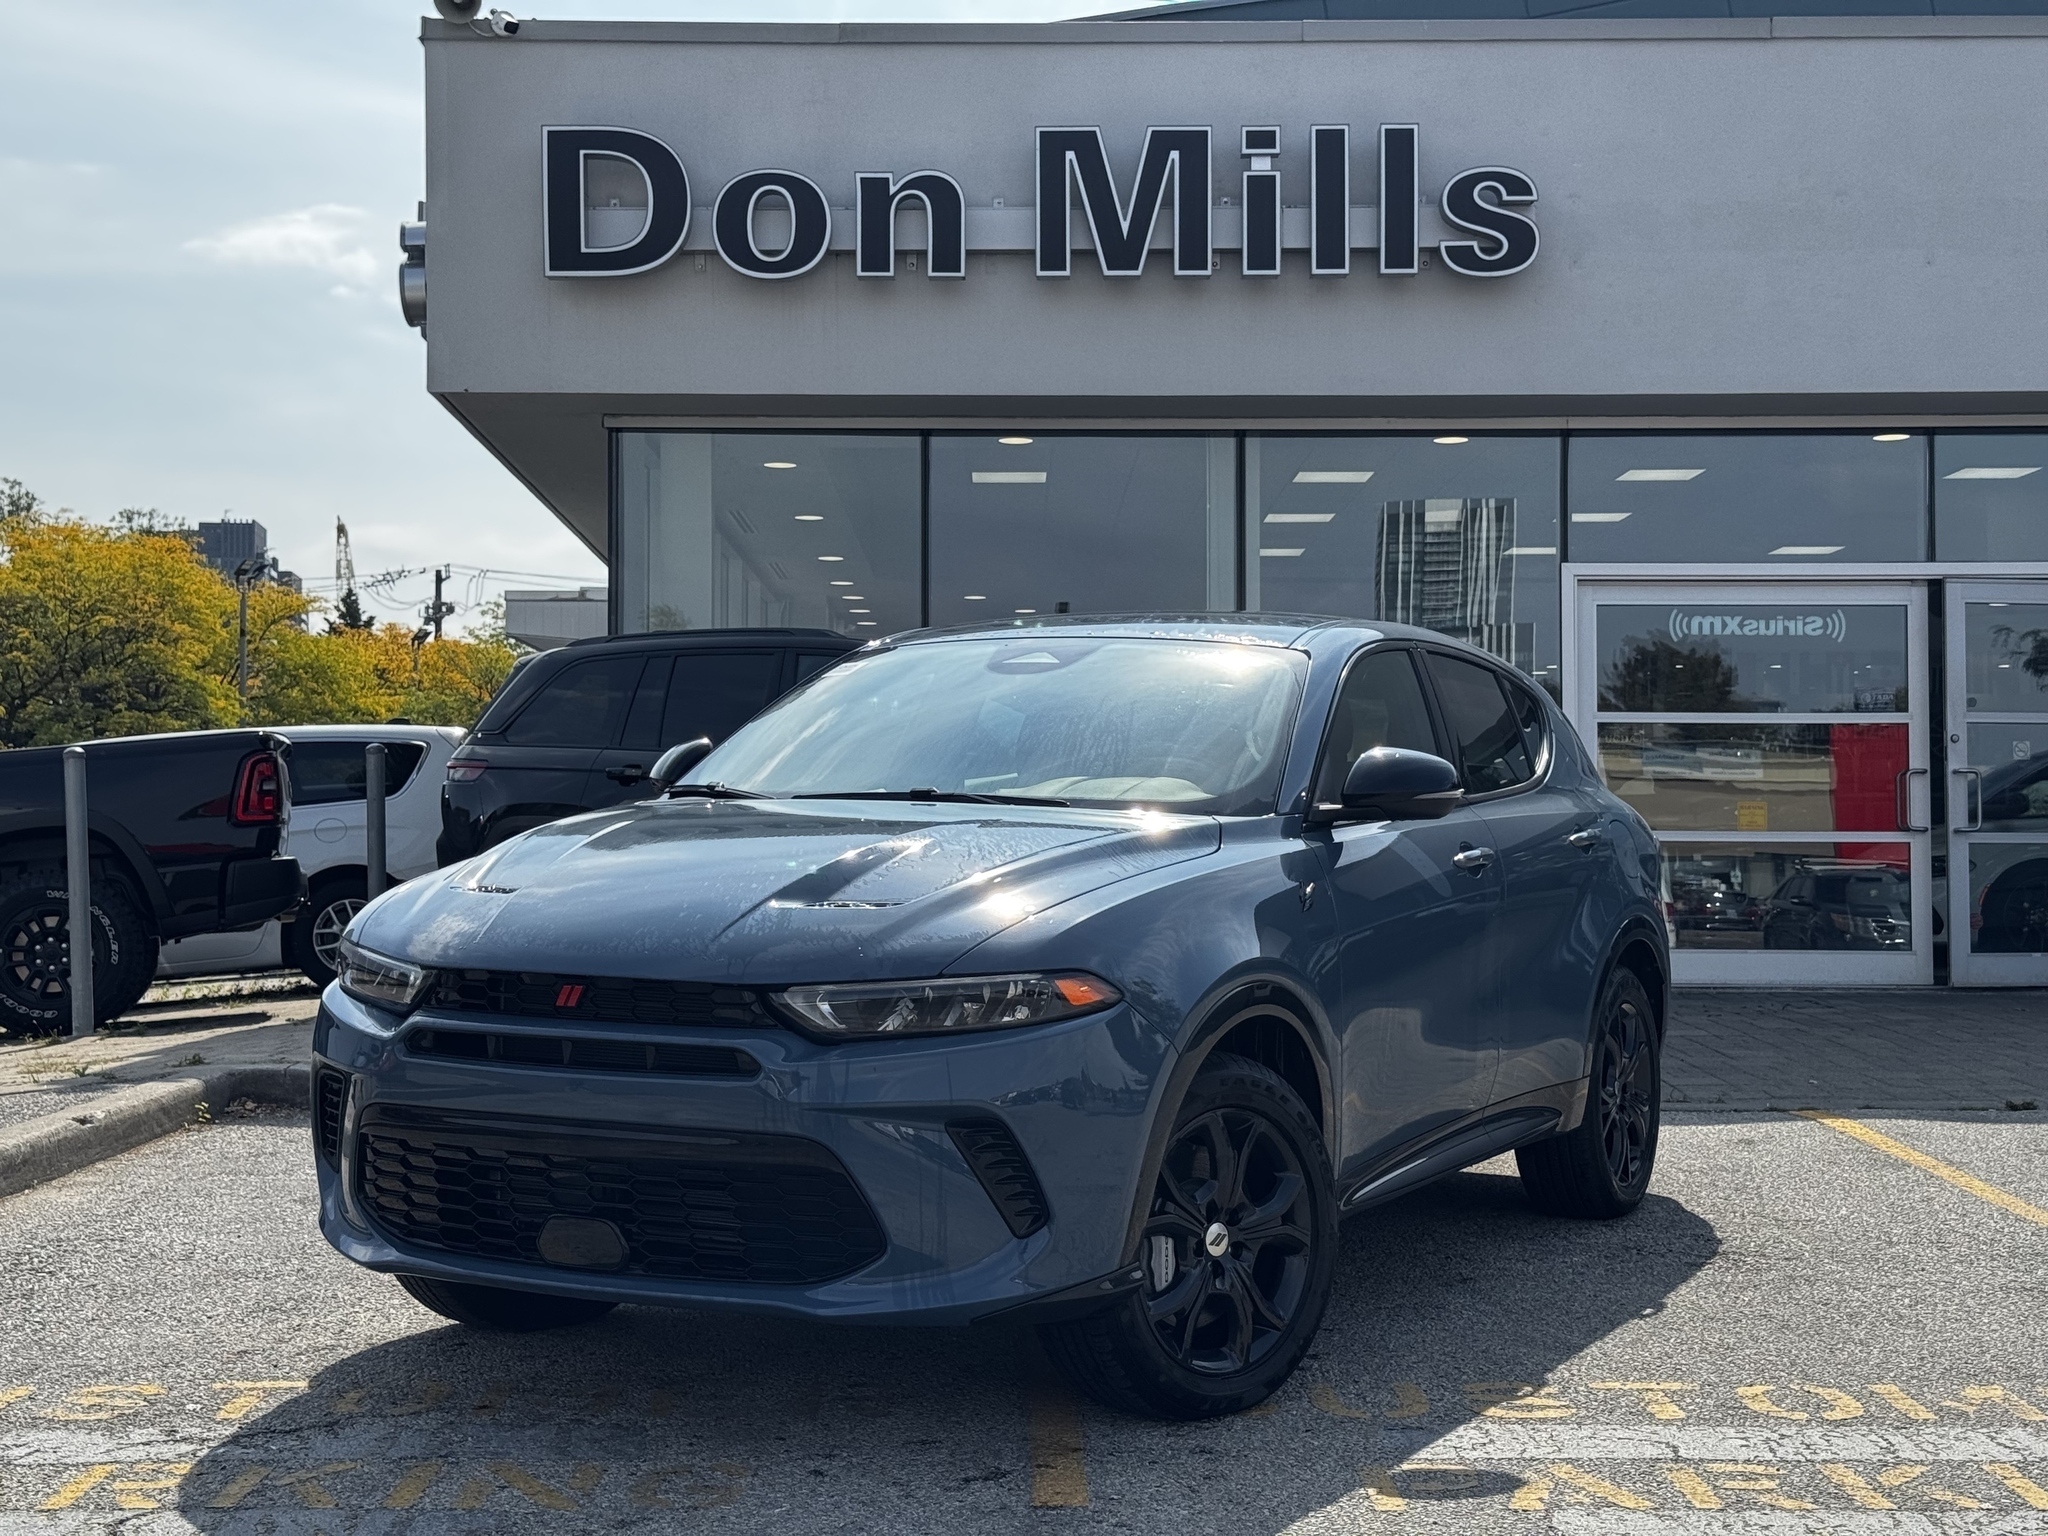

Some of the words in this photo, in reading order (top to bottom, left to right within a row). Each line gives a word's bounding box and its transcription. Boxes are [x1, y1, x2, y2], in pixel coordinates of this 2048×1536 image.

[541, 124, 967, 280] Don
[1034, 123, 1541, 279] Mills
[46, 889, 119, 965] WNGLER
